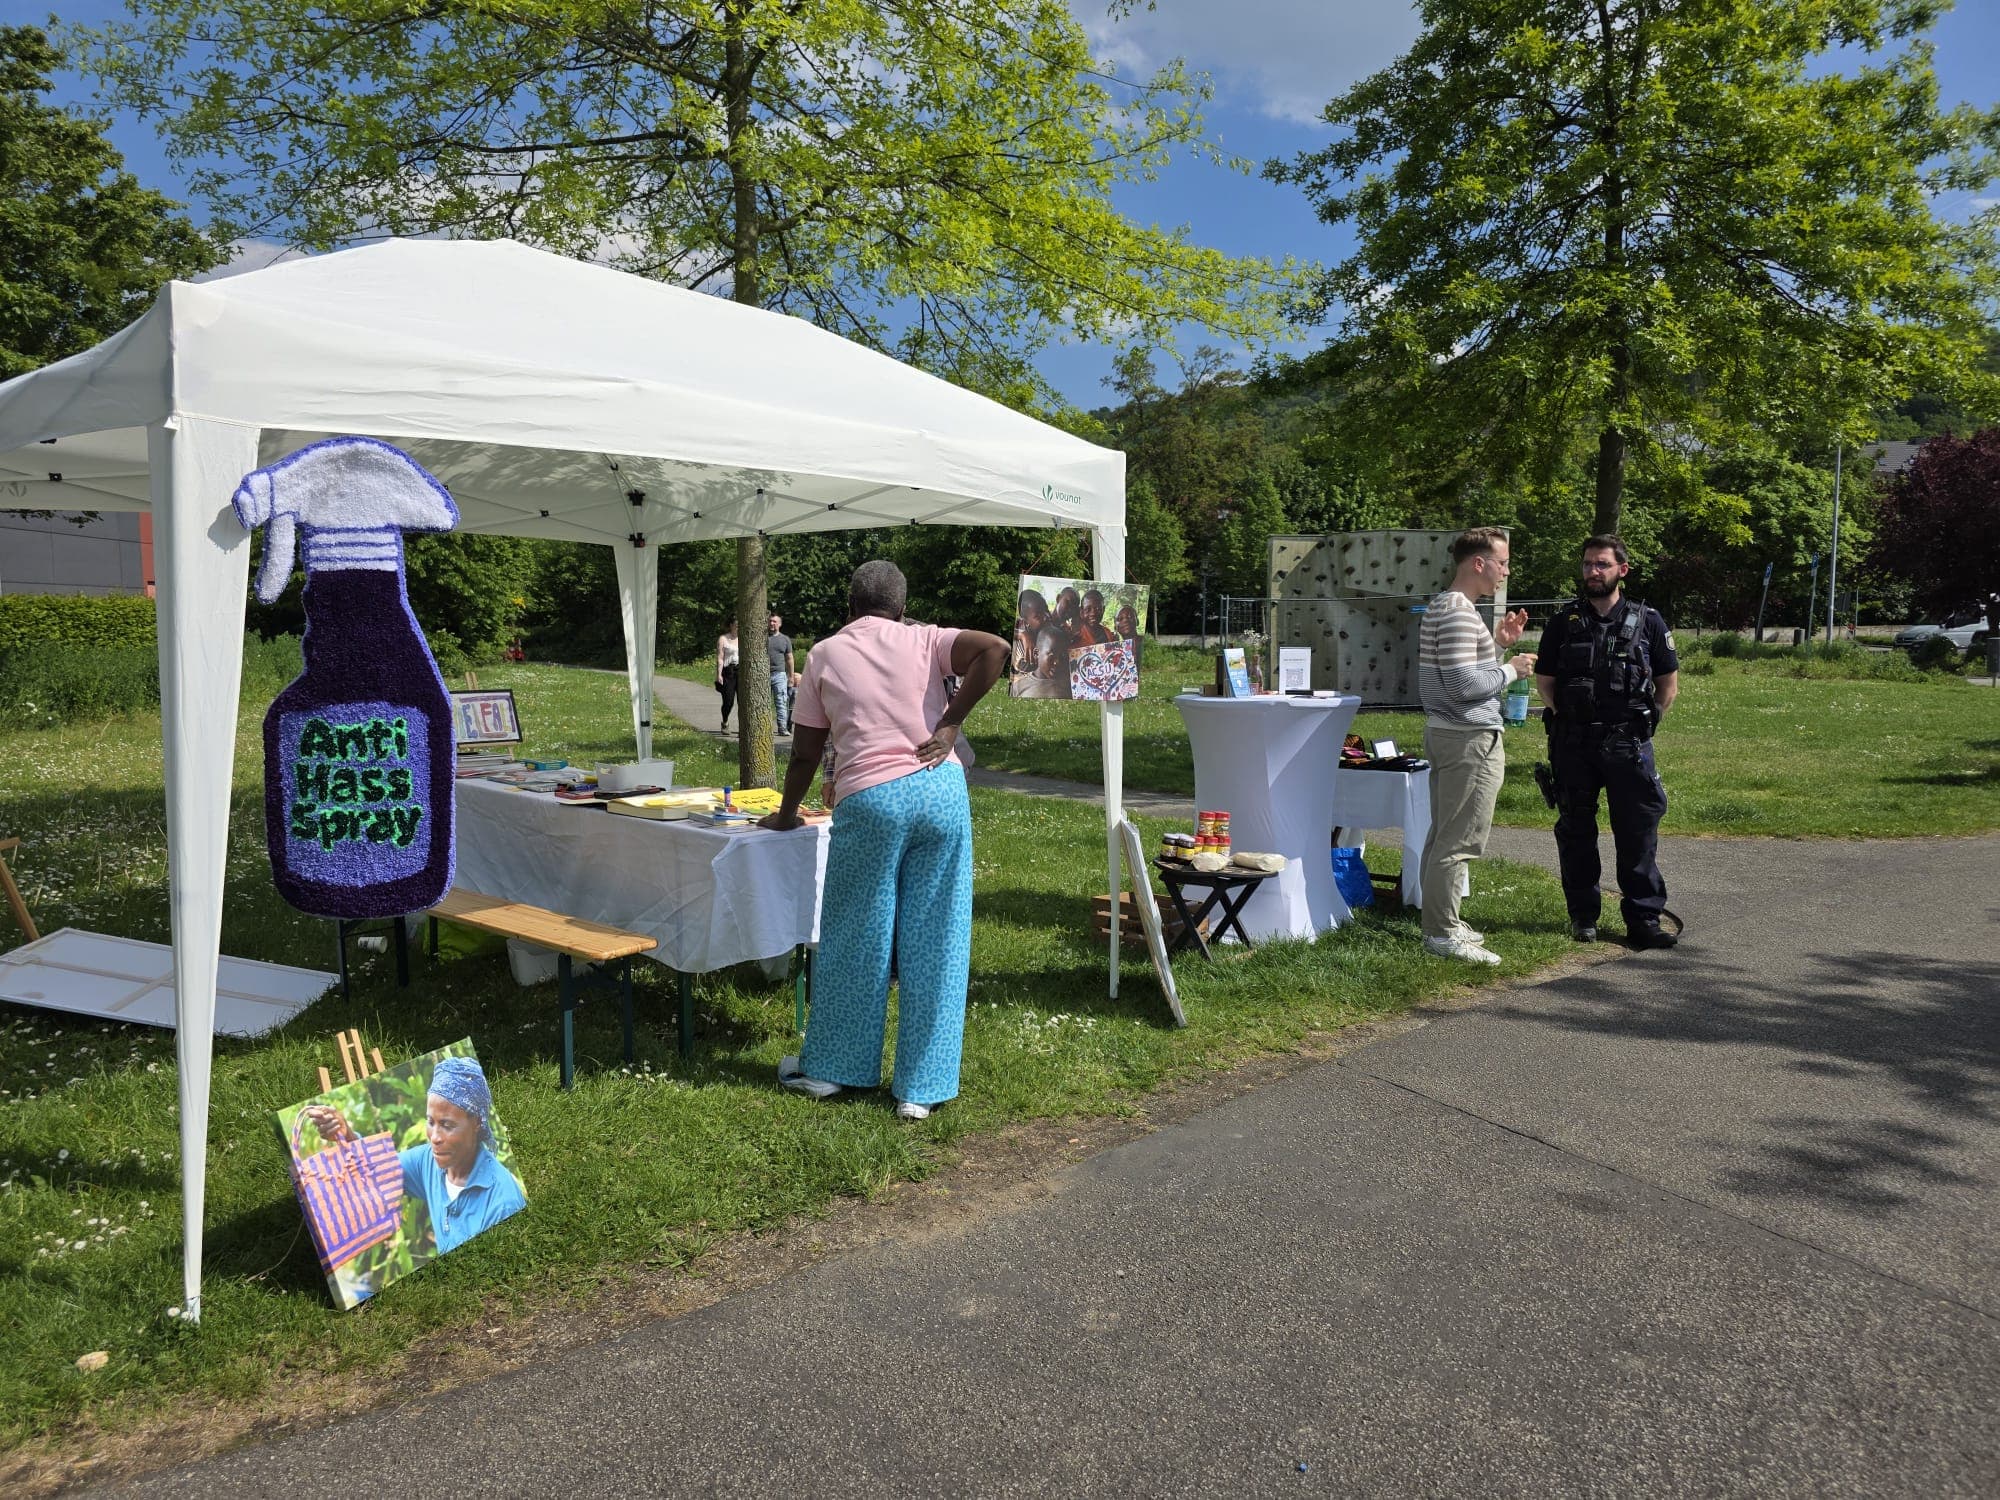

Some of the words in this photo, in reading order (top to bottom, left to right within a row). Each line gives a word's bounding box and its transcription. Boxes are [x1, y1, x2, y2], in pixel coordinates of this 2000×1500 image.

[300, 717, 408, 762] Anti
[294, 761, 412, 803] Hass
[290, 801, 424, 852] Spray
